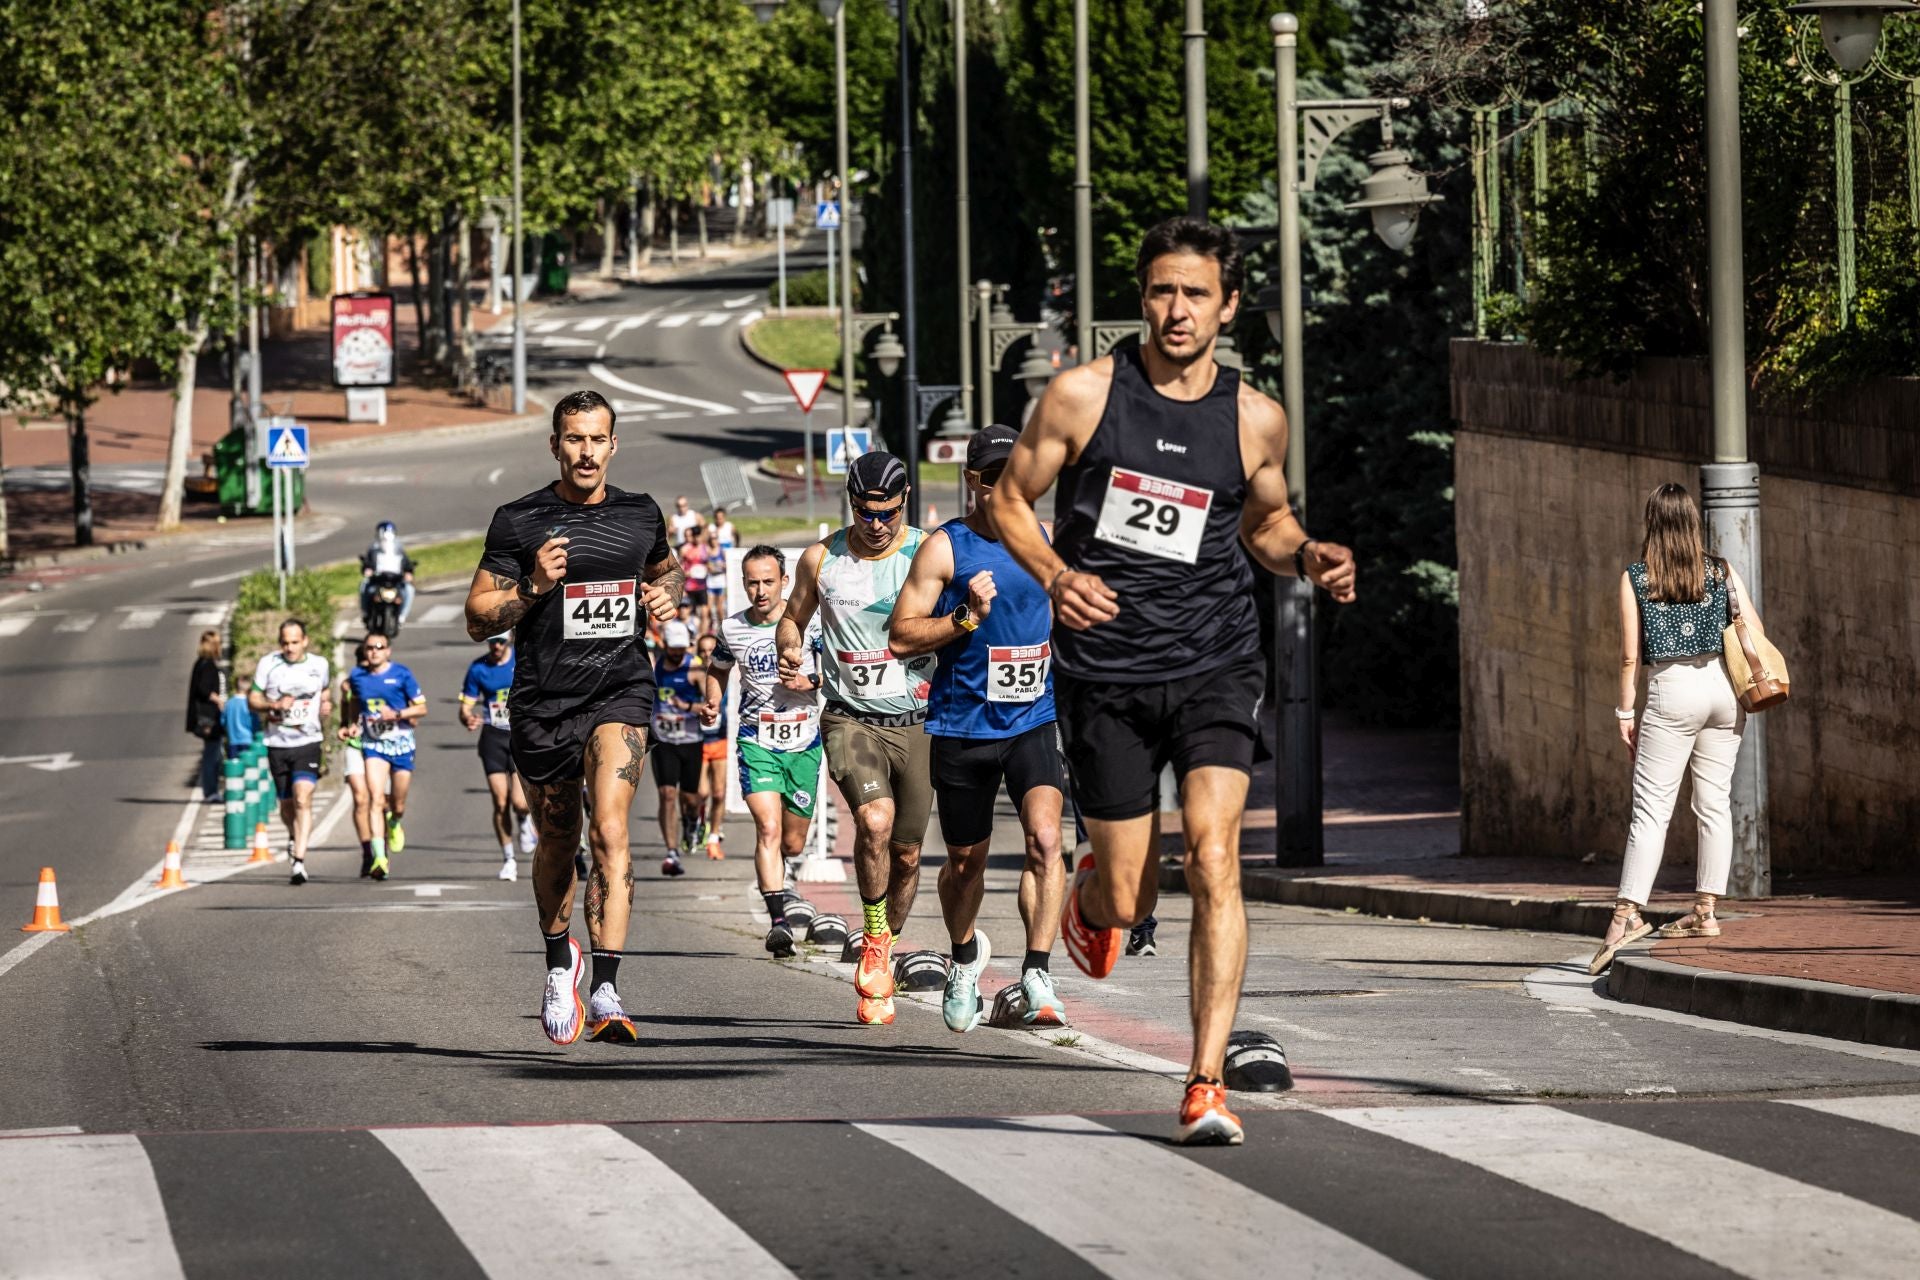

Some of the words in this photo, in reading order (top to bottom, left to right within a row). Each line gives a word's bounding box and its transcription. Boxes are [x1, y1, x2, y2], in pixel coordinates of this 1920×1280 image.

[1138, 478, 1185, 500] 33MM
[1125, 498, 1181, 536] 29
[585, 584, 619, 594] 33MM
[572, 597, 630, 623] 442
[748, 653, 777, 666] MAT
[852, 651, 885, 660] 33MM
[1010, 648, 1042, 658] 33MM
[851, 663, 888, 687] 37
[997, 660, 1045, 687] 351
[766, 722, 802, 740] 181
